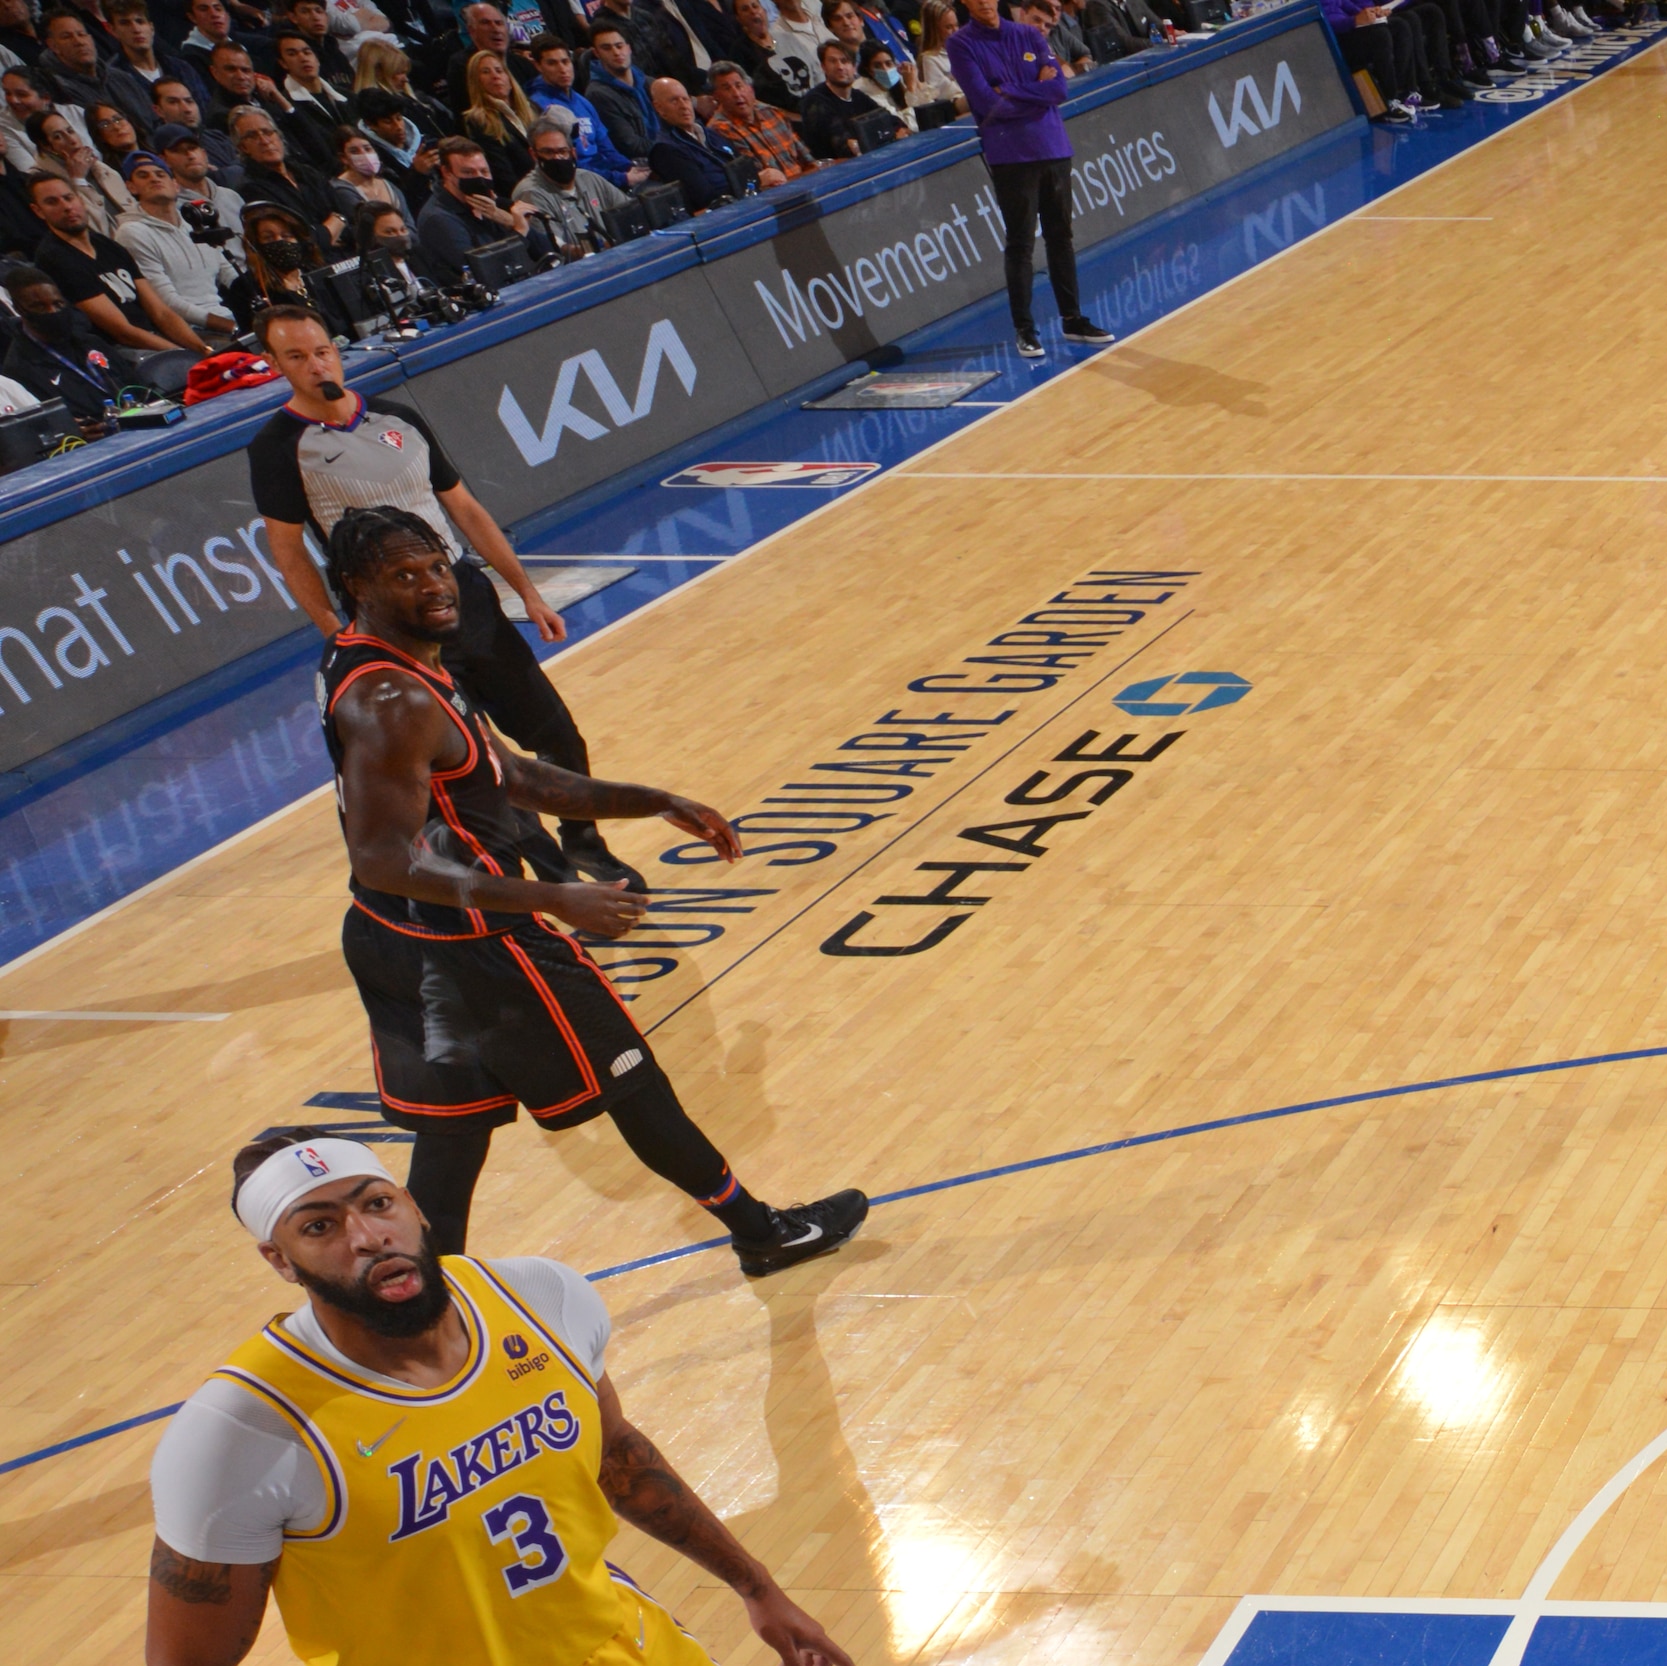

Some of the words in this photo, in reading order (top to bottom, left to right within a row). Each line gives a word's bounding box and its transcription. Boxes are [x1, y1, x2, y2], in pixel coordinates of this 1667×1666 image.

[754, 203, 982, 349] Movement
[658, 709, 1018, 867] SQUARE
[906, 571, 1204, 693] GARDEN
[819, 729, 1188, 957] CHASE
[506, 1351, 550, 1381] bibigo
[387, 1390, 581, 1544] LAKERS
[480, 1491, 570, 1600] 3
